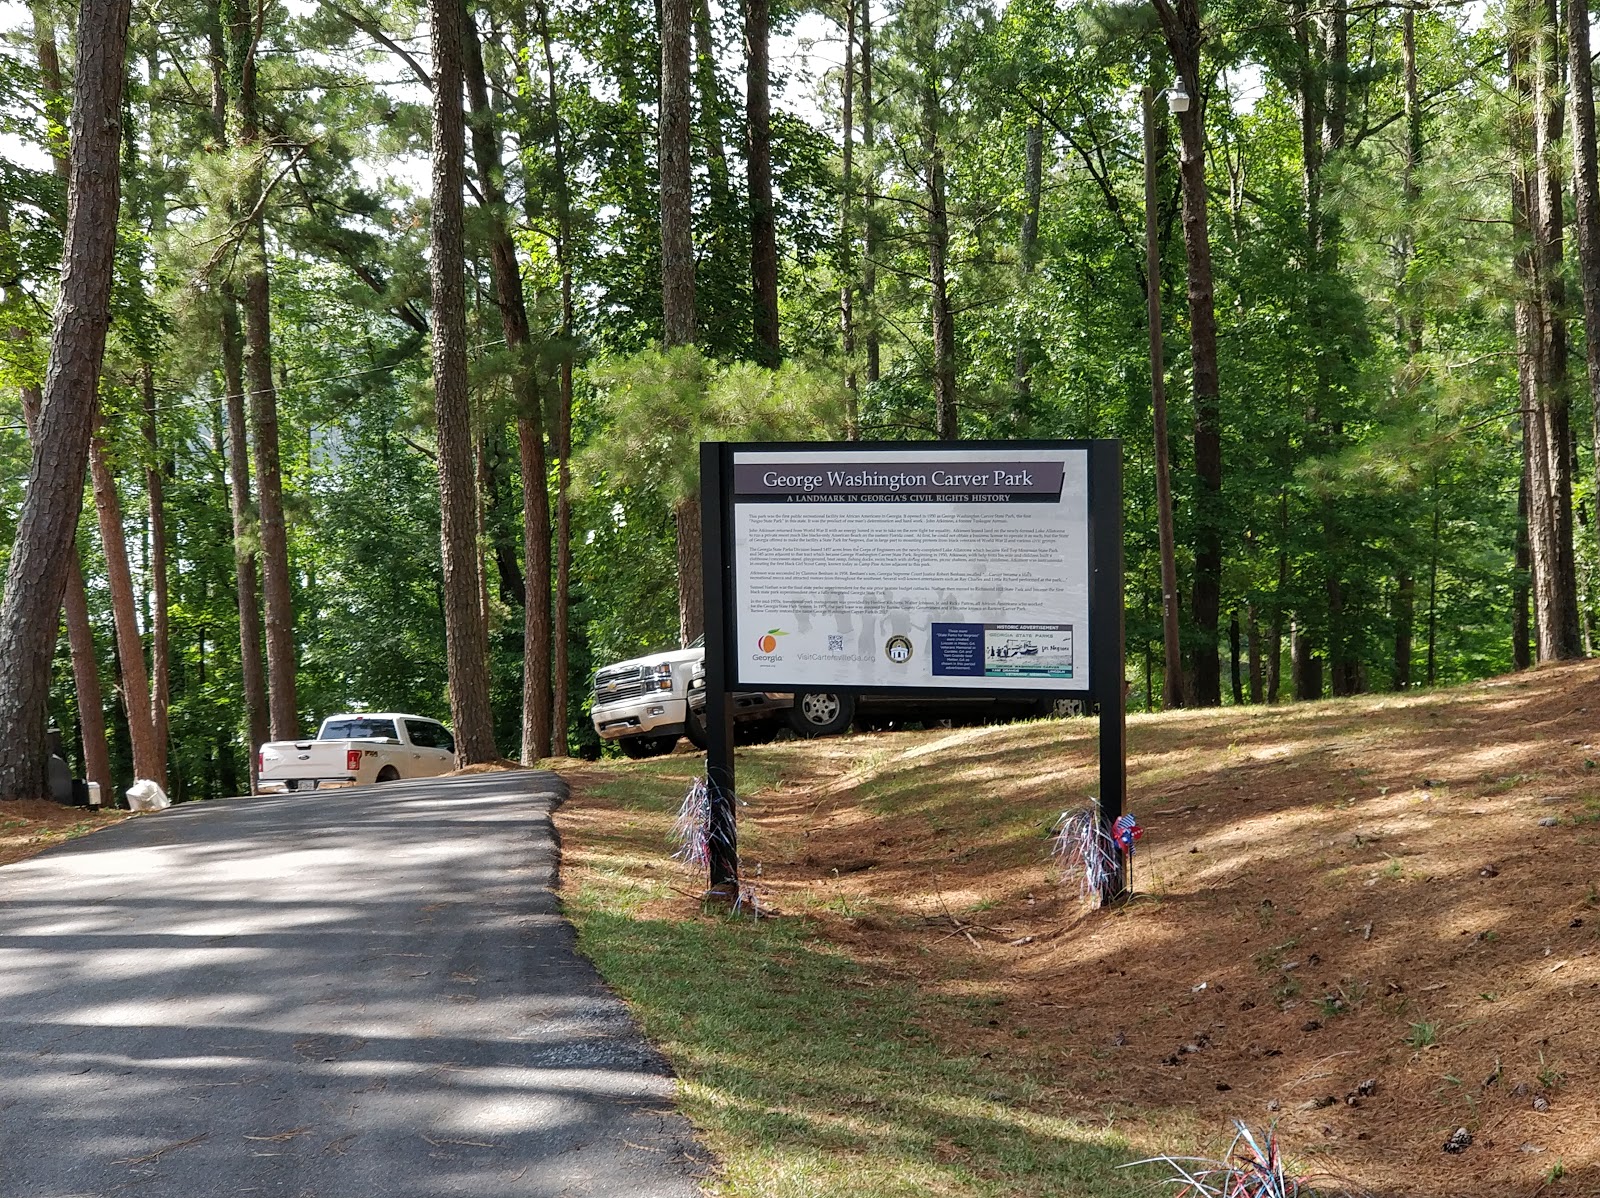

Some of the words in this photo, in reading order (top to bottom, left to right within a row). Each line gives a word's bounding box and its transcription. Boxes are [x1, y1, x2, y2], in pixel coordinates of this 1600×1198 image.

[763, 472, 823, 491] George
[827, 471, 926, 491] Washington
[932, 470, 989, 486] Carver
[993, 470, 1033, 486] Park
[861, 494, 907, 502] GEORGIA'S
[910, 494, 933, 502] CIVIL
[936, 494, 969, 502] RIGHTS
[972, 494, 1010, 502] HISTORY
[752, 654, 783, 663] Georgia
[797, 653, 876, 663] VisitCartersvilleGa.org
